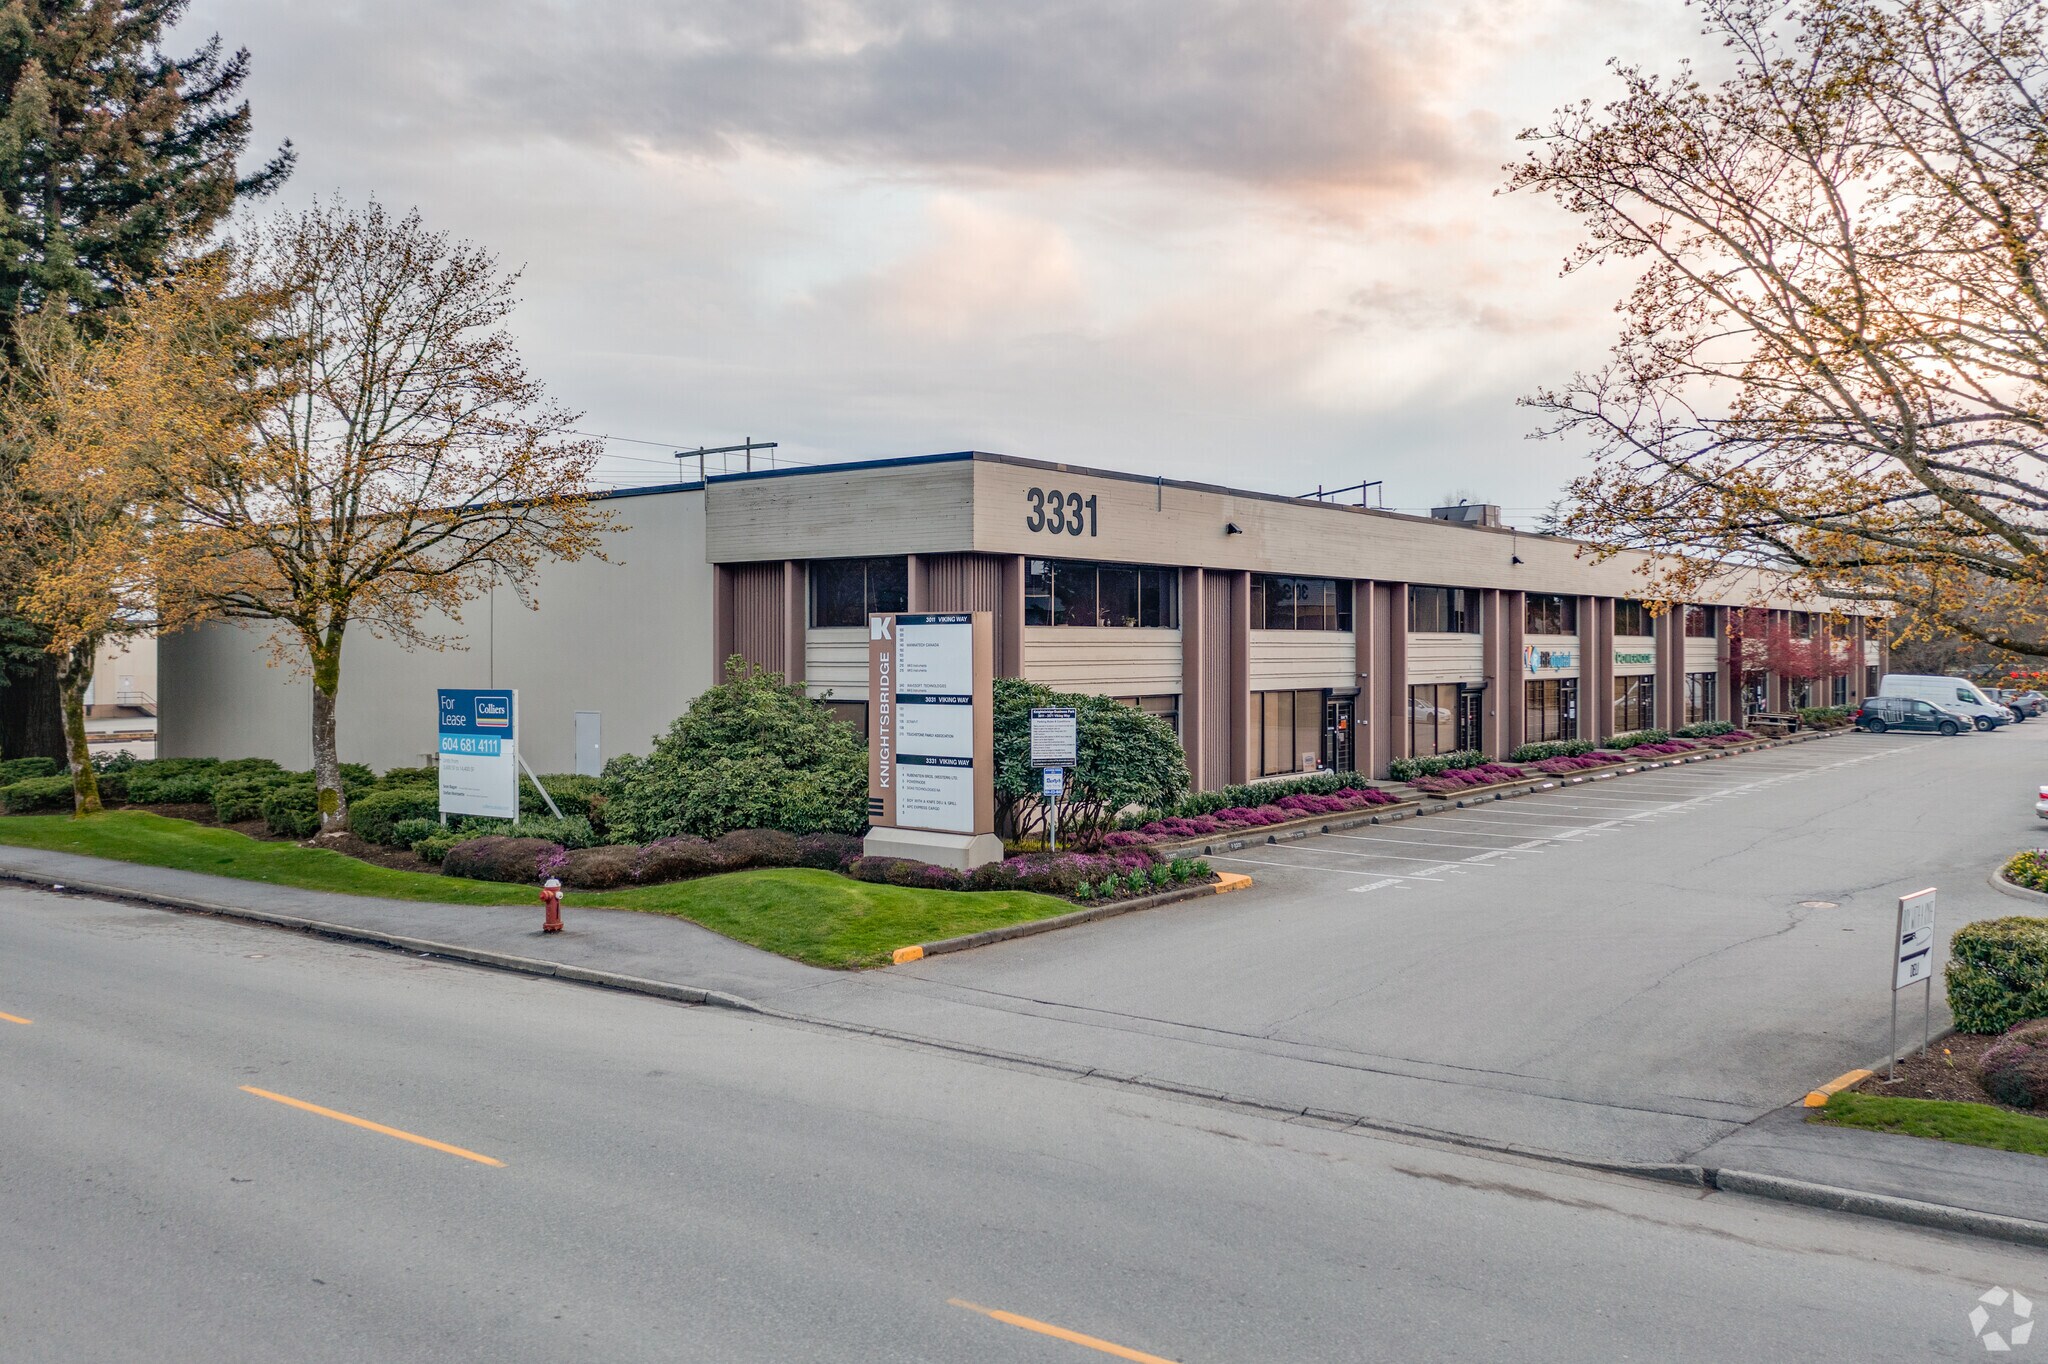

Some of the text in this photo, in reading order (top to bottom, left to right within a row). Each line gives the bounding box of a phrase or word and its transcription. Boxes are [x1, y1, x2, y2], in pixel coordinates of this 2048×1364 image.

[1026, 487, 1097, 537] 3331
[441, 695, 455, 710] For
[478, 703, 505, 714] Colliers
[442, 712, 466, 726] Lease
[880, 652, 890, 788] KNIGHTSBRIDGE
[442, 737, 498, 753] 604 681 4111
